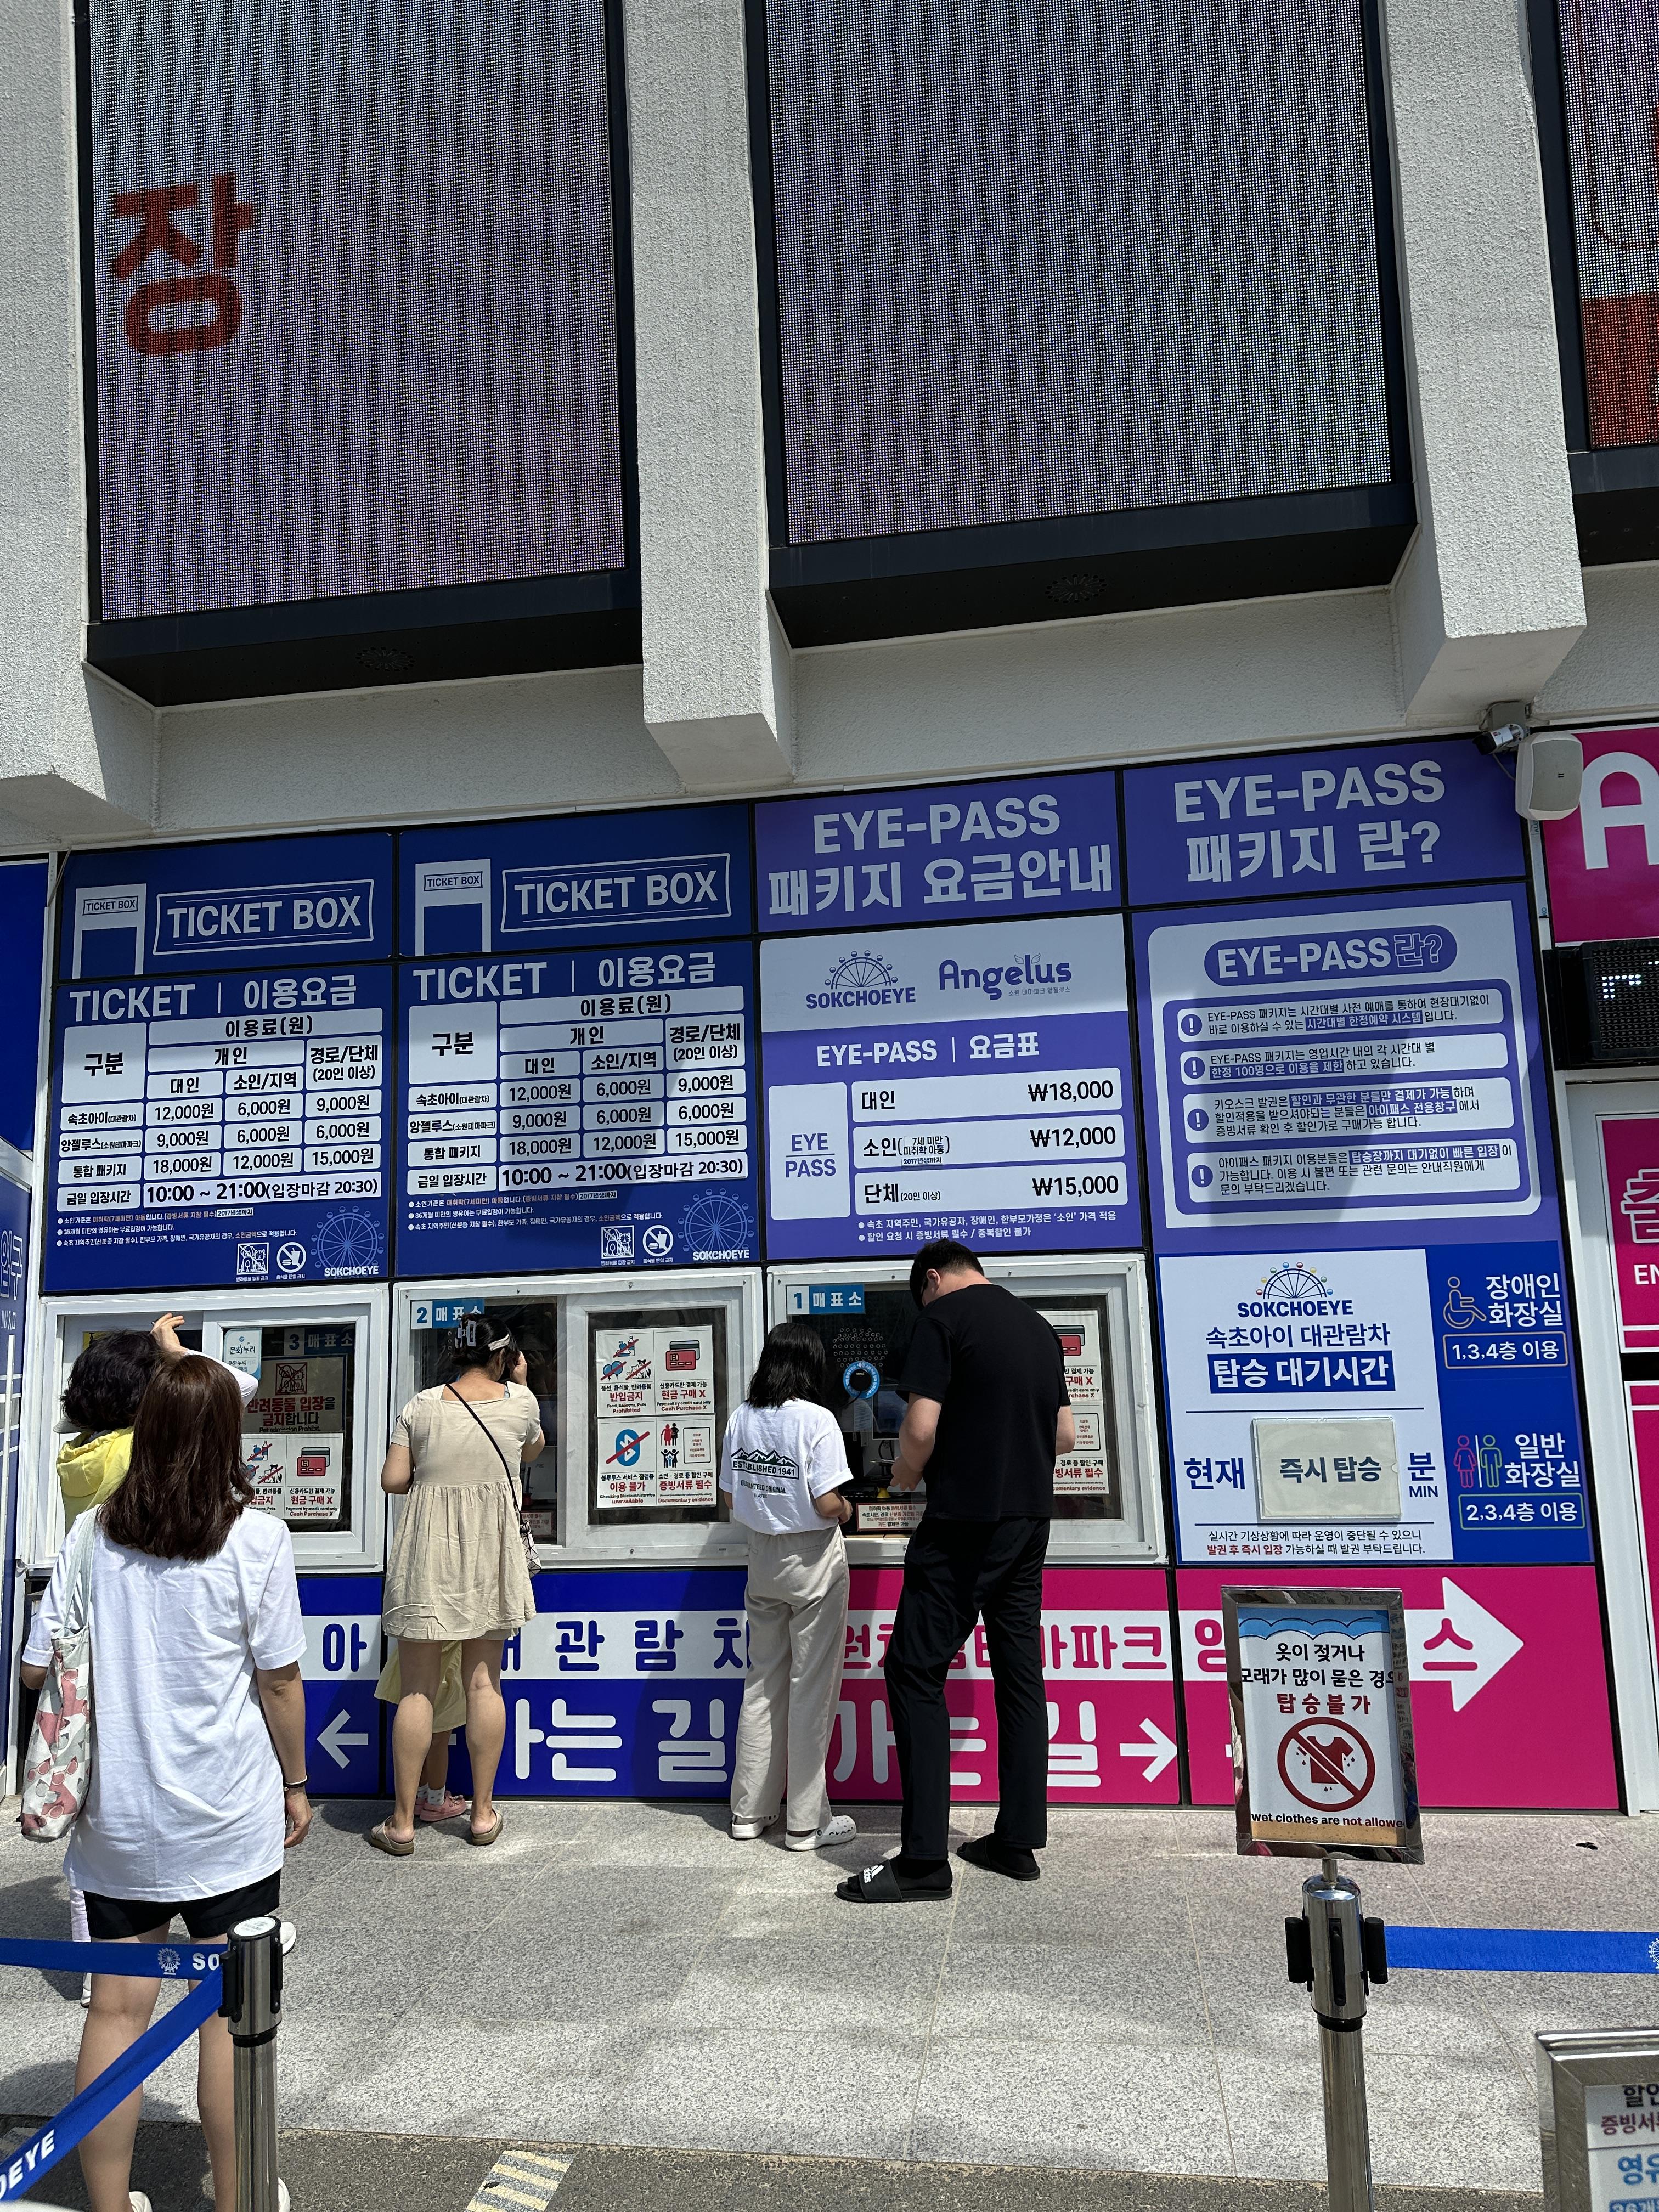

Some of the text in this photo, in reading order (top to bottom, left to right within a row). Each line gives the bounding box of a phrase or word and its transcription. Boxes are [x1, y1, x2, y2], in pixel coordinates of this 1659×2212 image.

[1175, 760, 1444, 826] EYE-PASS
[814, 794, 1060, 854] EYE-PASS
[1187, 820, 1440, 882] 패키지 란?
[427, 874, 480, 887] TICKET BOX
[769, 844, 1112, 915] 패키지 요금안내
[515, 871, 718, 915] TICKET BOX
[86, 898, 136, 911] TICKET BOX
[167, 896, 360, 938] TICKET BOX
[1217, 933, 1443, 979] EYE-PASS란?
[413, 952, 715, 1000] TICKET 이용요금
[939, 952, 1072, 1001] Angelus
[70, 975, 356, 1022] TICKET 이용요금
[580, 994, 672, 1017] 이용료(원)
[806, 987, 916, 1009] SOKCHOEYE
[1208, 995, 1488, 1022] EYE-PASS 패키지는 시간대별 사전 통하여 현장대기없이
[225, 1015, 313, 1037] 이용료(원)
[670, 1023, 740, 1043] 경로/단체
[1209, 1012, 1421, 1035] 바로 이용하실 있는 시간대별 한정예약 시스템
[432, 1032, 473, 1056] 구분
[571, 1026, 603, 1045] 개인
[215, 1047, 247, 1065] 개인
[311, 1045, 378, 1064] 경로/단체
[674, 1045, 737, 1062] (20인 이상)
[817, 1032, 1039, 1066] EYE-PASS 요금표
[84, 1052, 123, 1076] 구분
[525, 1058, 554, 1074] 대인
[591, 1052, 656, 1070] 소인/지역
[234, 1072, 296, 1090] 소인/지역
[313, 1065, 375, 1082] (20인 이상)
[171, 1077, 199, 1093] 대인
[510, 1084, 571, 1102] 12,000원
[597, 1079, 651, 1098] 6,000원
[679, 1075, 733, 1093] 9,000원
[862, 1080, 1113, 1110] 대인 ₩18,000
[513, 1111, 566, 1130] 9,000원
[597, 1107, 651, 1125] 6,000원
[679, 1102, 733, 1121] 6,000원
[594, 1133, 656, 1152] 12,000원
[676, 1129, 739, 1148] 15,000원
[792, 1133, 828, 1151] EYE
[927, 1136, 943, 1145] 미만
[1030, 1126, 1115, 1148] ₩12,000
[424, 1146, 480, 1160] 통합 패키지
[510, 1138, 571, 1156] 18,000원
[904, 1146, 927, 1155] 미취학
[313, 1148, 373, 1166] 15,000원
[73, 1164, 126, 1178] 통합 패키지
[503, 1159, 742, 1186] 10:00 20:30)
[786, 1159, 836, 1177] PASS
[418, 1173, 487, 1188] 금일 입장시간
[1032, 1176, 1118, 1197] ₩15,000
[67, 1190, 131, 1205] 금일 입장시간
[148, 1185, 194, 1203] 10:00
[867, 1211, 1116, 1229] 속초 한부모가정은 가격 적용
[693, 1250, 749, 1260] SOKCHOEYE
[324, 1266, 379, 1277] SOKCHOEYE
[1486, 1273, 1560, 1300] 장애인
[794, 1292, 861, 1309] 1 매표소
[1238, 1300, 1353, 1317] SOKCHOEYE
[417, 1307, 427, 1323] 2
[1488, 1301, 1563, 1327] 화장실
[289, 1333, 352, 1350] 3 매표소
[1206, 1323, 1390, 1348] 속초아이 대관람차
[1453, 1341, 1559, 1360] 1,3,4층 이용
[1214, 1356, 1389, 1387] 탑승 대기시간
[610, 1391, 642, 1402] 반입금지
[662, 1389, 696, 1400] 현금 구매
[263, 1412, 319, 1426] 금지합니다
[1515, 1433, 1565, 1459] 일반
[733, 1460, 776, 1474] ESTABLISHED
[1054, 1468, 1082, 1478] 빙서류
[1184, 1453, 1435, 1489] 현재 즉시 탑승 분
[1505, 1461, 1581, 1488] 화장실
[610, 1481, 645, 1492] 이용 불가
[659, 1480, 712, 1491] 증빙서류 필수
[1409, 1486, 1438, 1497] MIN
[1466, 1502, 1577, 1521] 2,3,4층 이용
[1209, 1530, 1421, 1541] 실시간 기상상황에 따라 운영이 중단될 있으니
[1207, 1543, 1425, 1555] 발권 즉시 입장 가능하실 발권 부탁드립니다.
[1276, 1643, 1364, 1662] 옷이 젖거나
[1242, 1668, 1287, 1685] 모래가
[1293, 1669, 1325, 1686] 많이
[1331, 1669, 1363, 1687] 묻은
[652, 1699, 727, 1782] 길
[1251, 1813, 1273, 1822] wet
[1276, 1813, 1318, 1824] clothes
[1343, 1817, 1362, 1826] not
[1365, 1818, 1407, 1828] allowe
[1601, 2112, 1659, 2135] 증빙서
